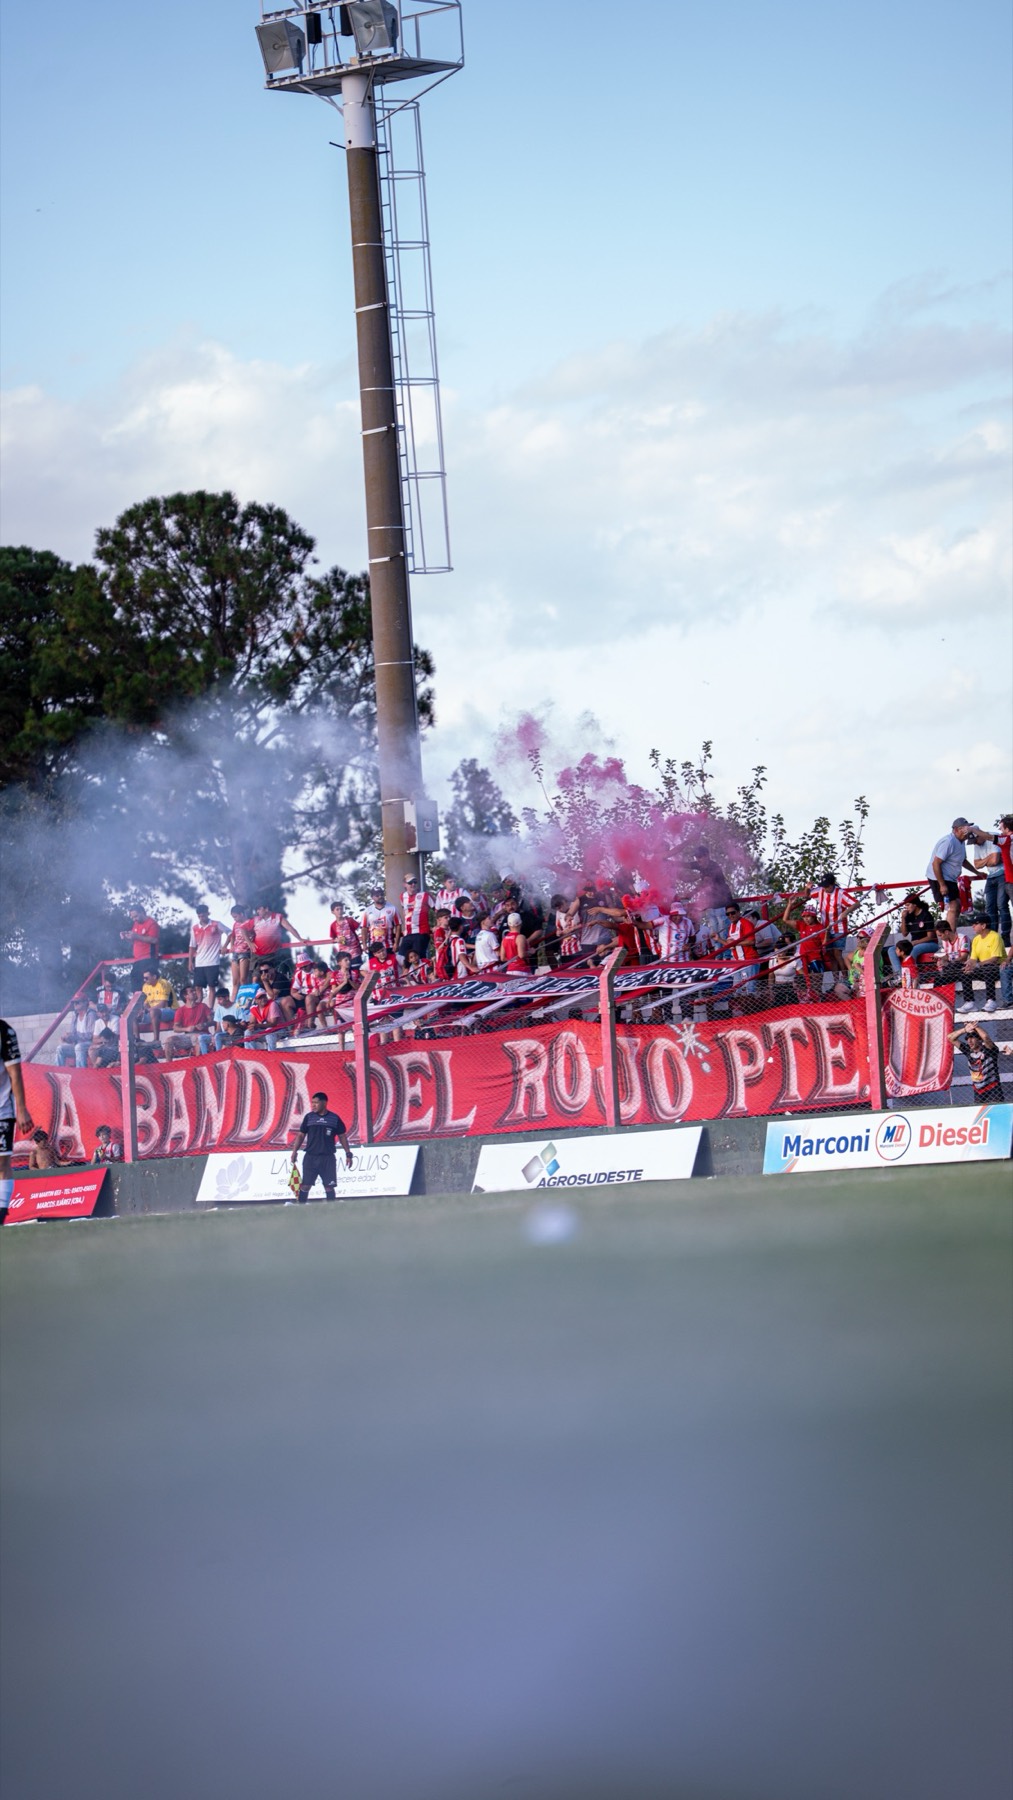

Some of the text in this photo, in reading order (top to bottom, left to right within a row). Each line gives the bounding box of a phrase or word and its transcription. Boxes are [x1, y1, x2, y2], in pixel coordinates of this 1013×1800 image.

[891, 993, 943, 1014] ARGENTINO
[902, 989, 932, 1004] CLUB
[112, 1059, 312, 1156] BANDA
[343, 1050, 477, 1146] DEL
[496, 1031, 694, 1127] ROJO
[782, 1119, 989, 1158] Marconi Diesel
[537, 1169, 643, 1188] AGROSUDESTE
